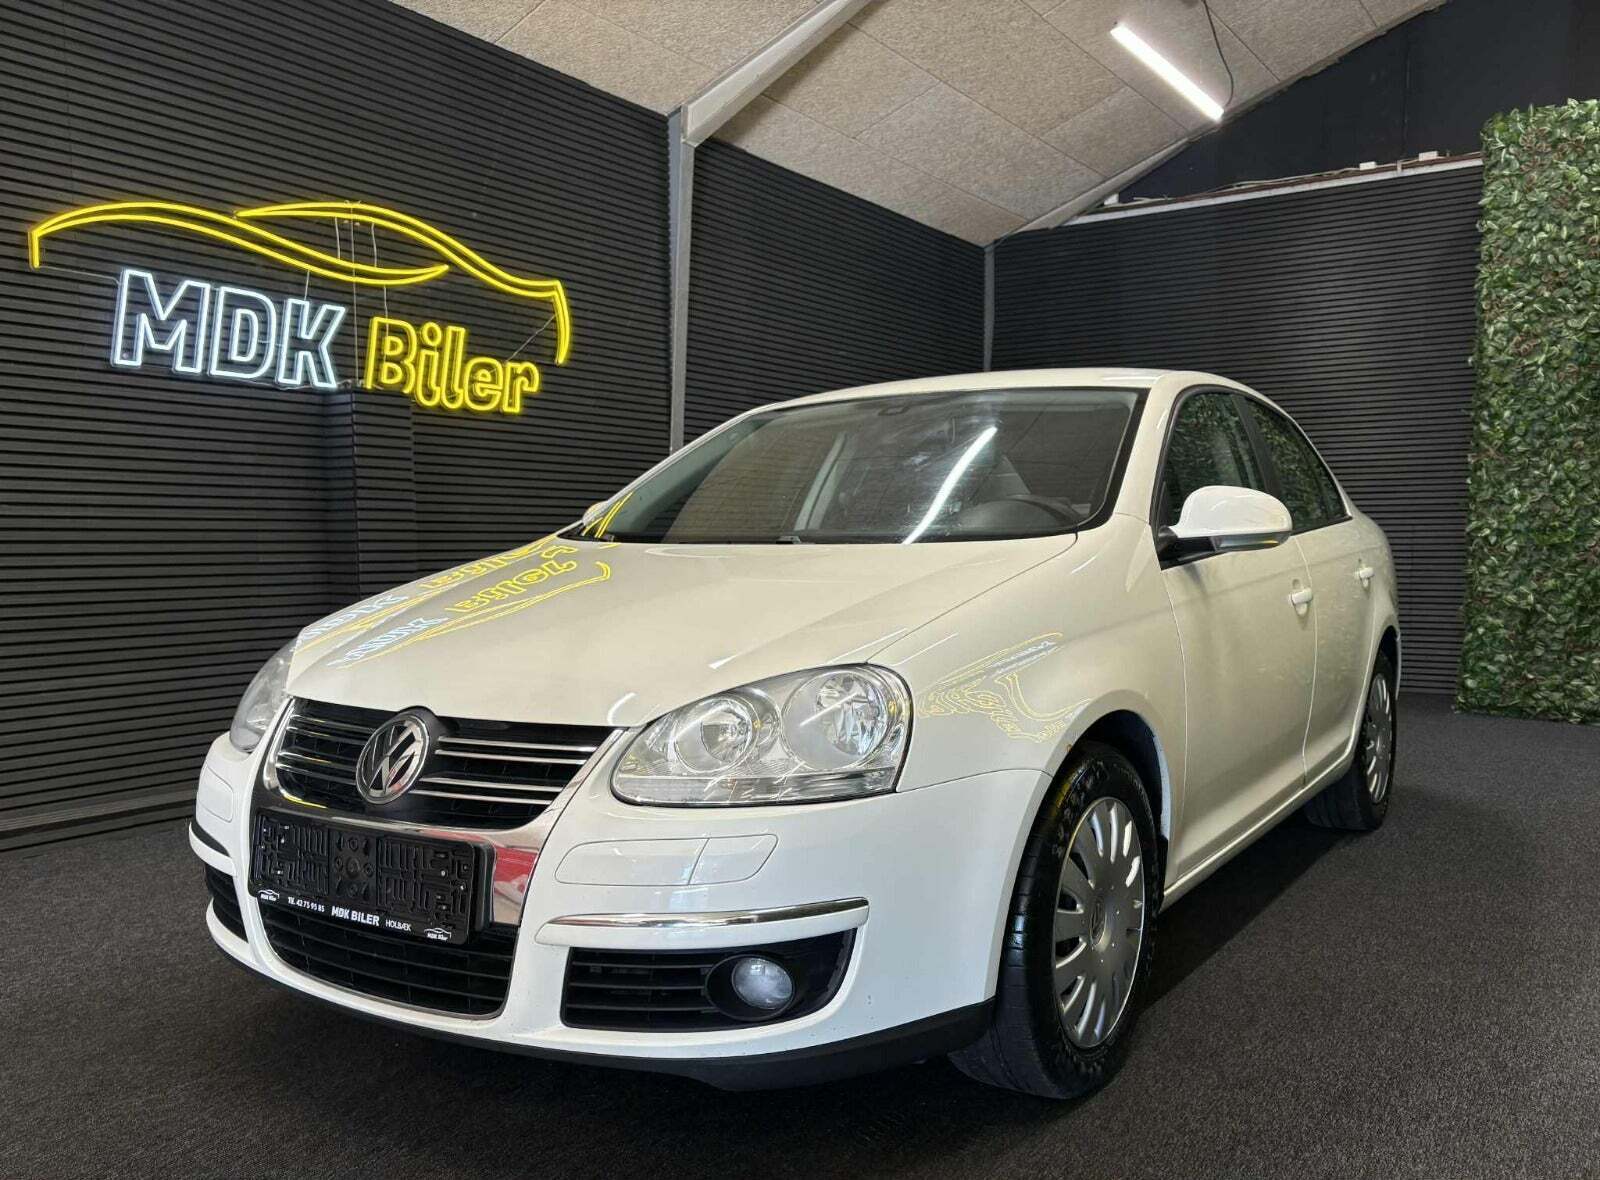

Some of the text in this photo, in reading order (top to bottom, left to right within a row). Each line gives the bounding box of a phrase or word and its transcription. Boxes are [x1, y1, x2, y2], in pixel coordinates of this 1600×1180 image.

[112, 269, 539, 412] MDK Biler
[357, 716, 428, 803] VW
[331, 905, 350, 919] MDK
[351, 910, 380, 927] BILER
